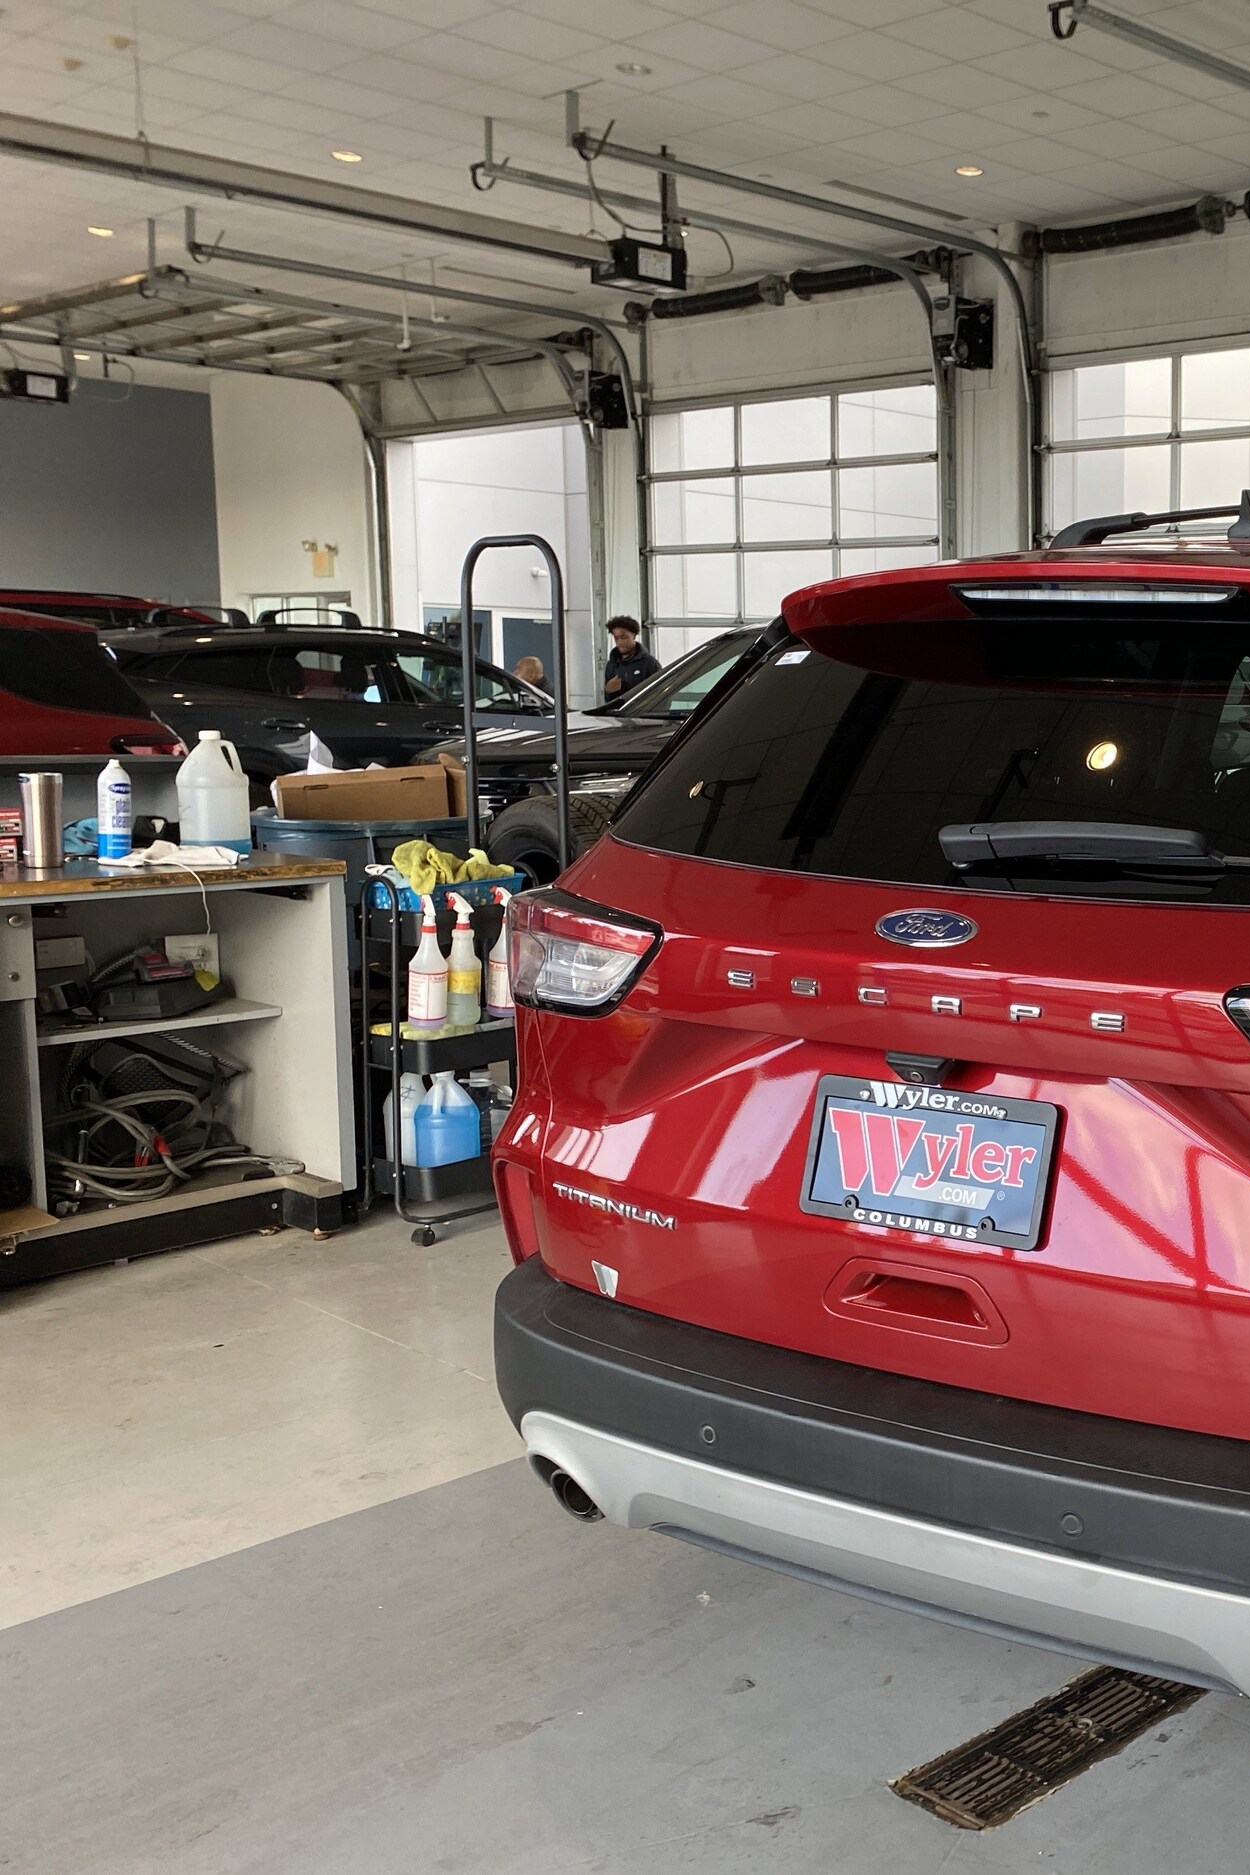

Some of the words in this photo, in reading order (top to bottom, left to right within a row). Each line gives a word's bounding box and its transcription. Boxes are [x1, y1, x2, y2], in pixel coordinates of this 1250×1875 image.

[894, 913, 953, 938] Ford
[727, 969, 1126, 1033] ESCAPE
[829, 1107, 1037, 1197] Wyler
[552, 1182, 677, 1230] TITANIUM
[853, 1208, 978, 1239] COLUMBUS
